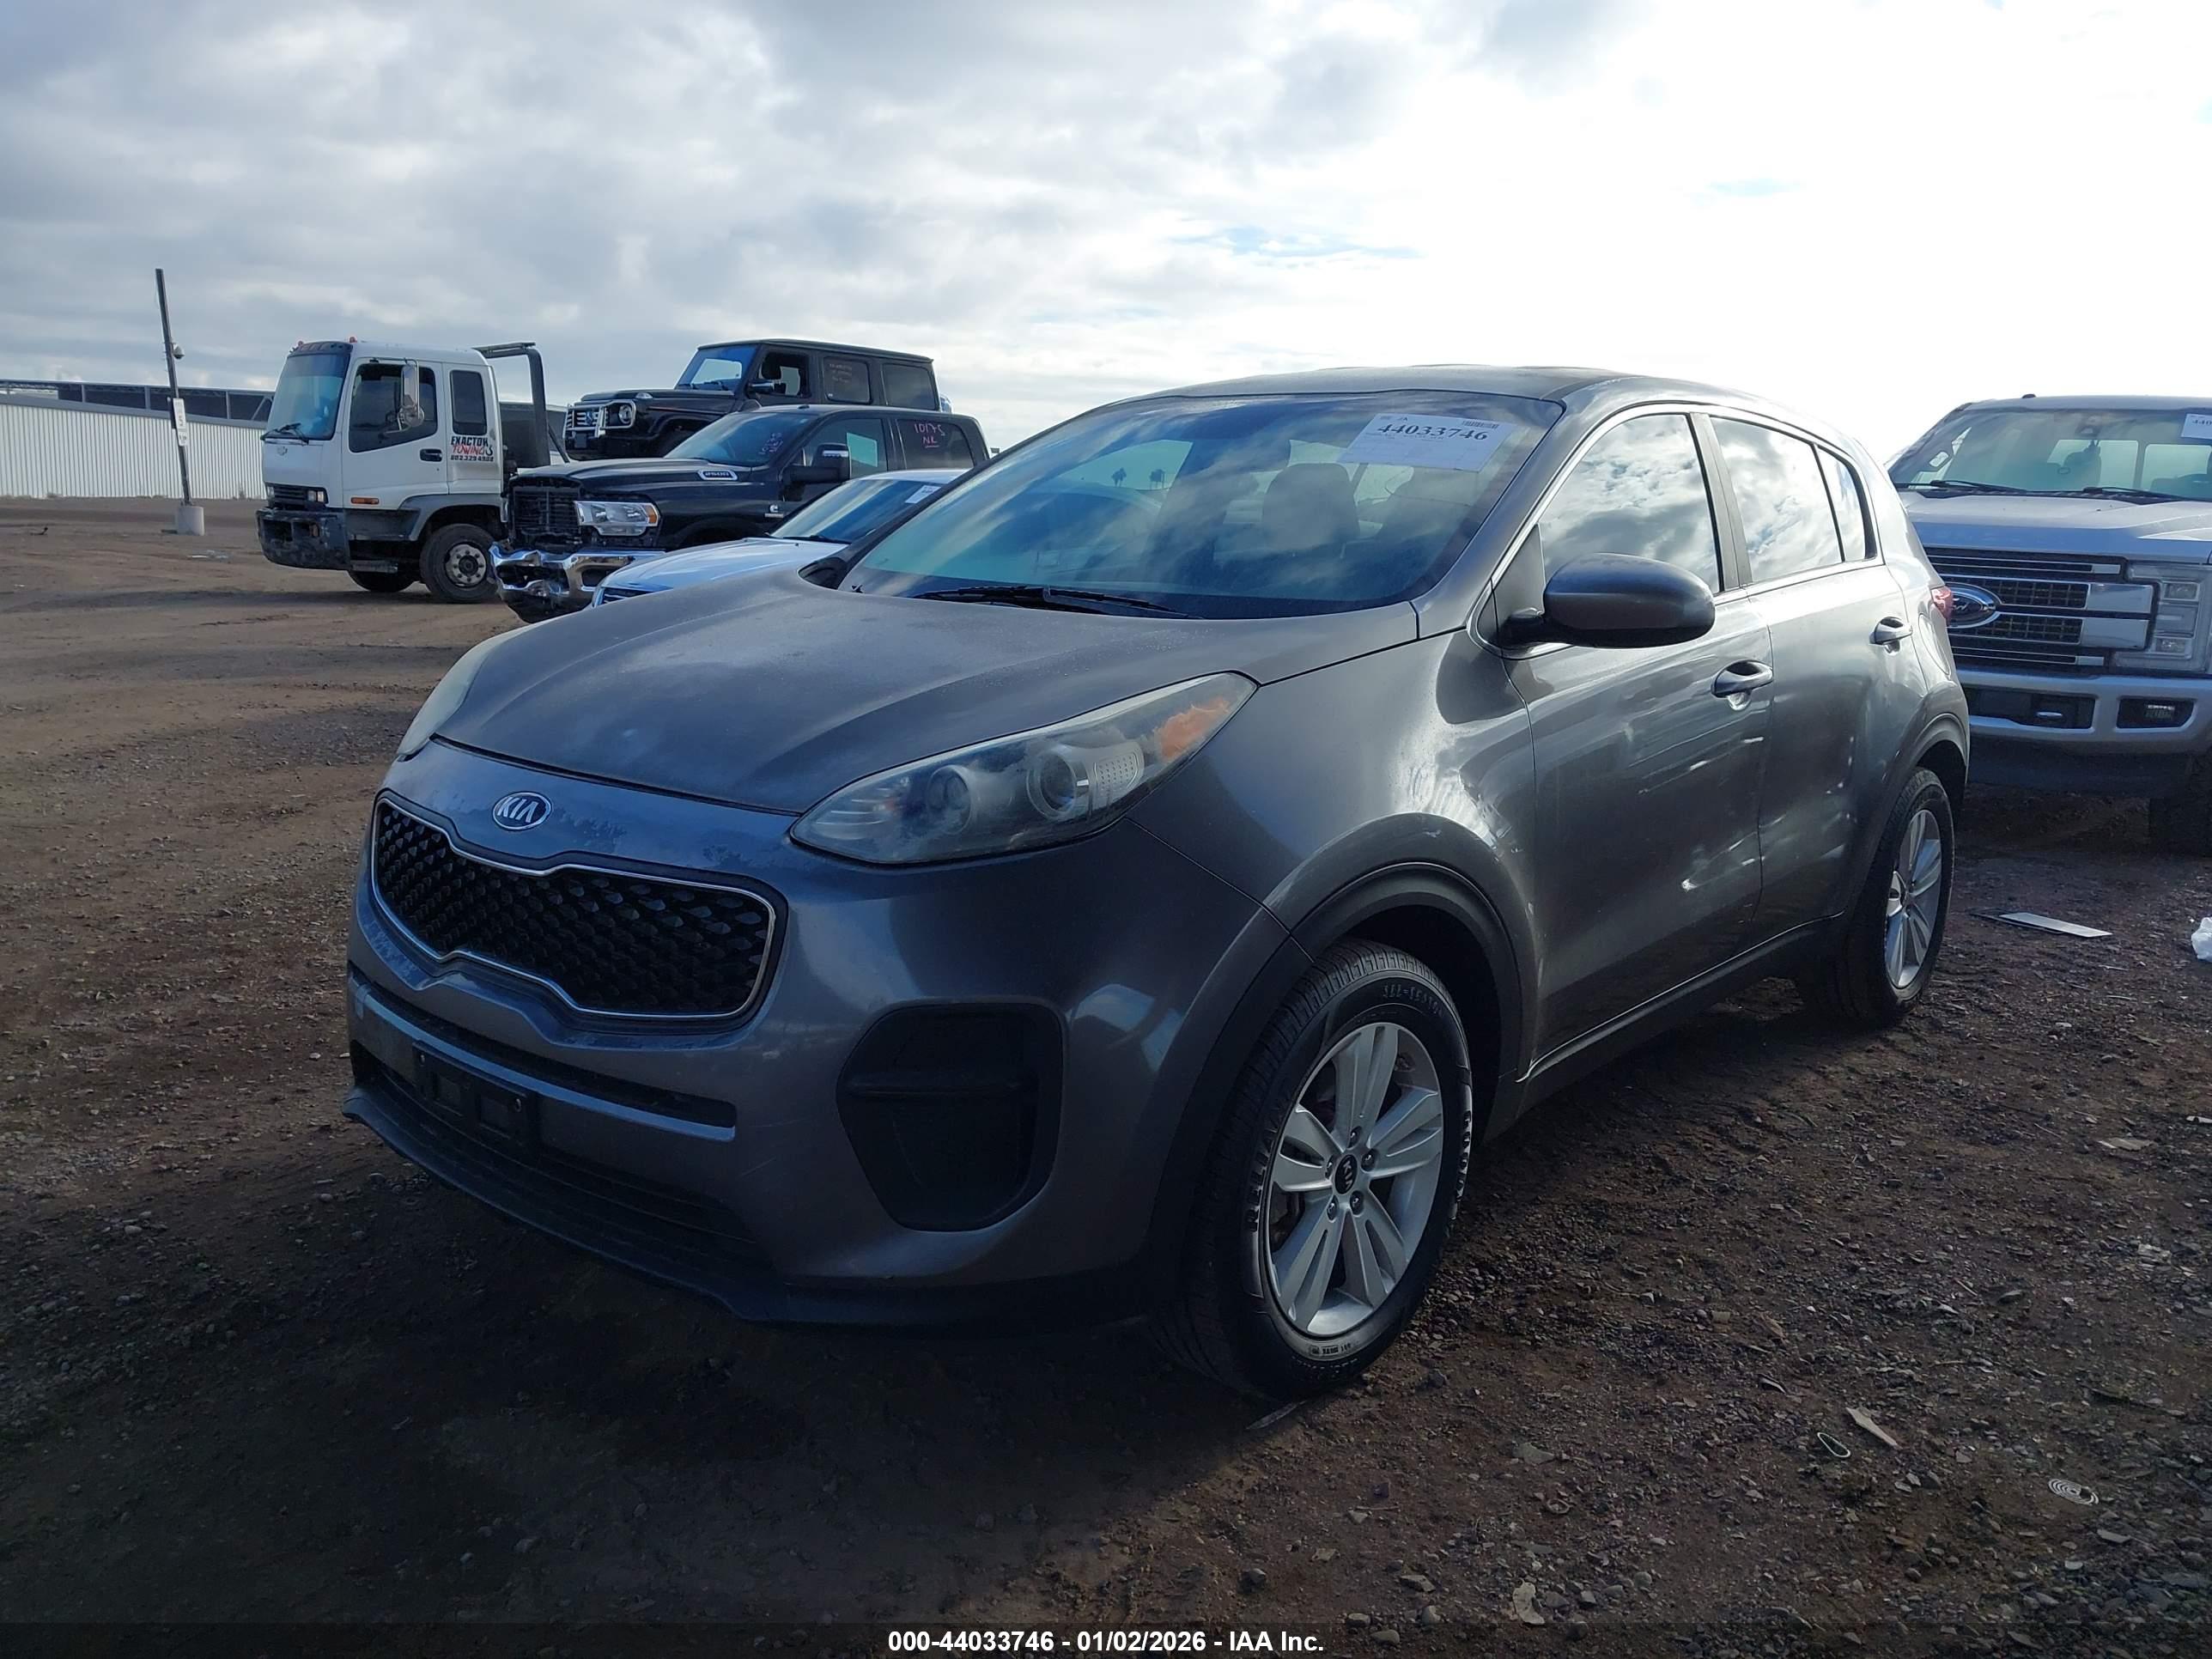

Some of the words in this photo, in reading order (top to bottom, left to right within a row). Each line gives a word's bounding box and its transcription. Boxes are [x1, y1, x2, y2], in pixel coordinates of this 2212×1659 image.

[1377, 423, 1489, 441] 44033746
[453, 445, 486, 455] TOWING
[497, 796, 539, 823] KIA
